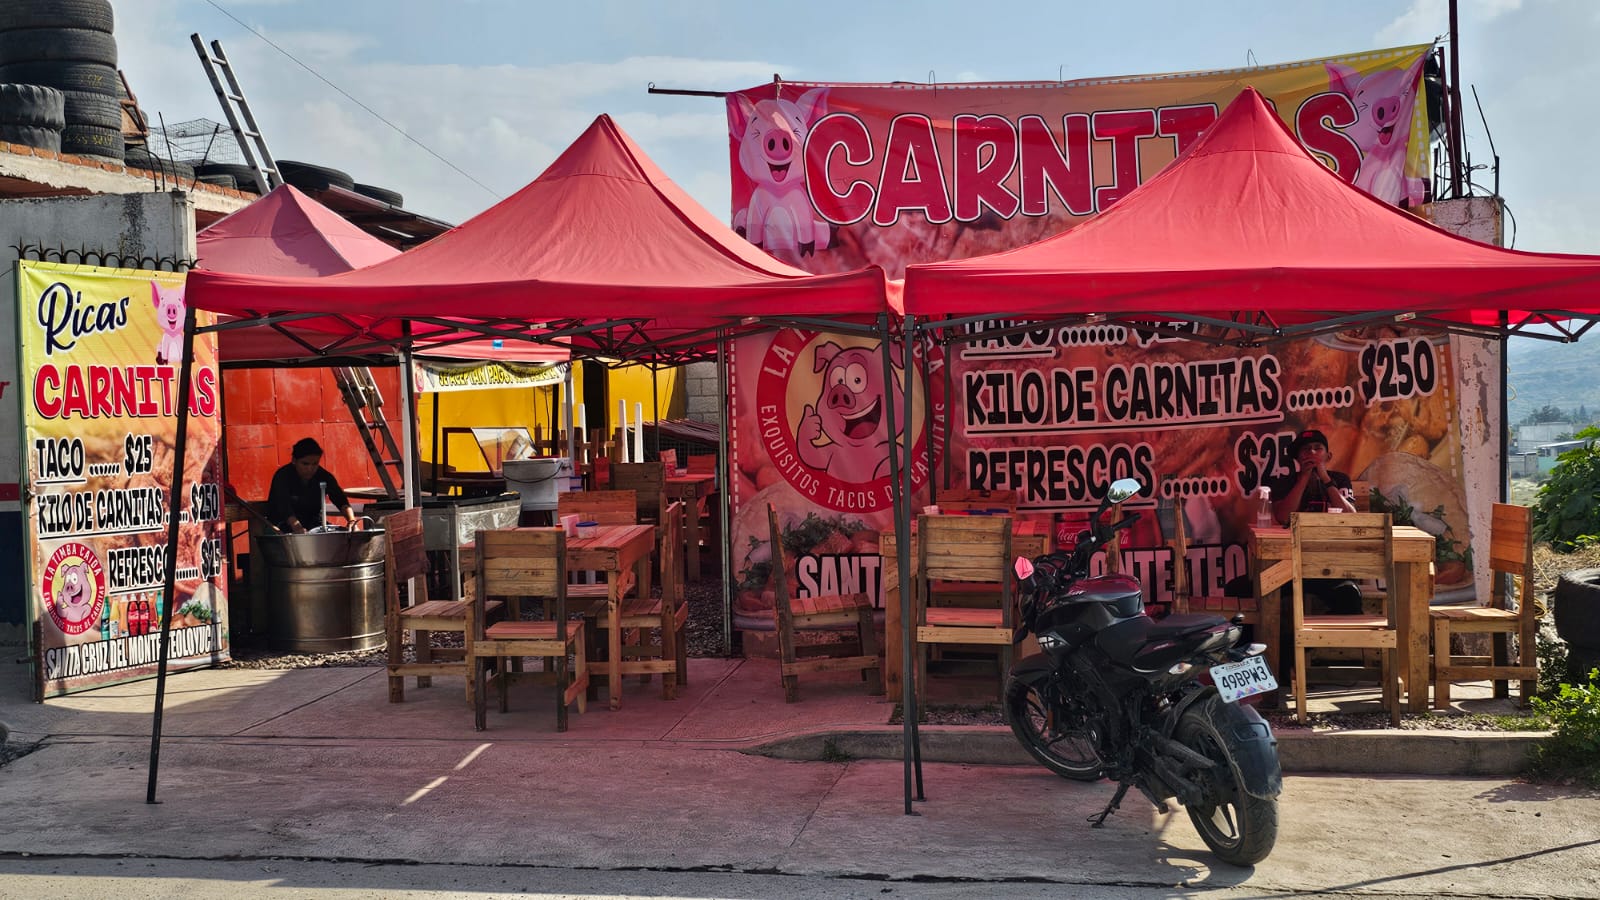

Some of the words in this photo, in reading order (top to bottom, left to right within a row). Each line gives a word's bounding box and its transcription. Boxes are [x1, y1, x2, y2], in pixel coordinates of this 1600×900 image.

[803, 91, 1364, 226] CARNITS
[38, 282, 130, 355] Ricas
[763, 343, 796, 379] LA
[966, 371, 1045, 426] KILO
[1054, 369, 1096, 423] DE
[1104, 358, 1278, 420] CARNITAS
[1362, 340, 1435, 404] $250
[36, 438, 84, 477] TACO
[124, 433, 152, 477] $25
[760, 404, 820, 496] EXQUISITOS
[827, 487, 877, 509] TACOS
[1238, 433, 1298, 496] $25
[37, 494, 73, 534] KILO
[75, 492, 93, 531] DE
[96, 488, 163, 529] CARNITAS
[191, 482, 219, 524] $250
[45, 566, 56, 581] LA
[52, 543, 77, 565] TIMBA
[202, 539, 221, 580] $25
[797, 554, 886, 609] SANT
[47, 645, 81, 680] SANTA
[81, 641, 109, 674] CRUZ
[109, 637, 128, 668] DEL
[1221, 666, 1268, 691] 49BPW3
